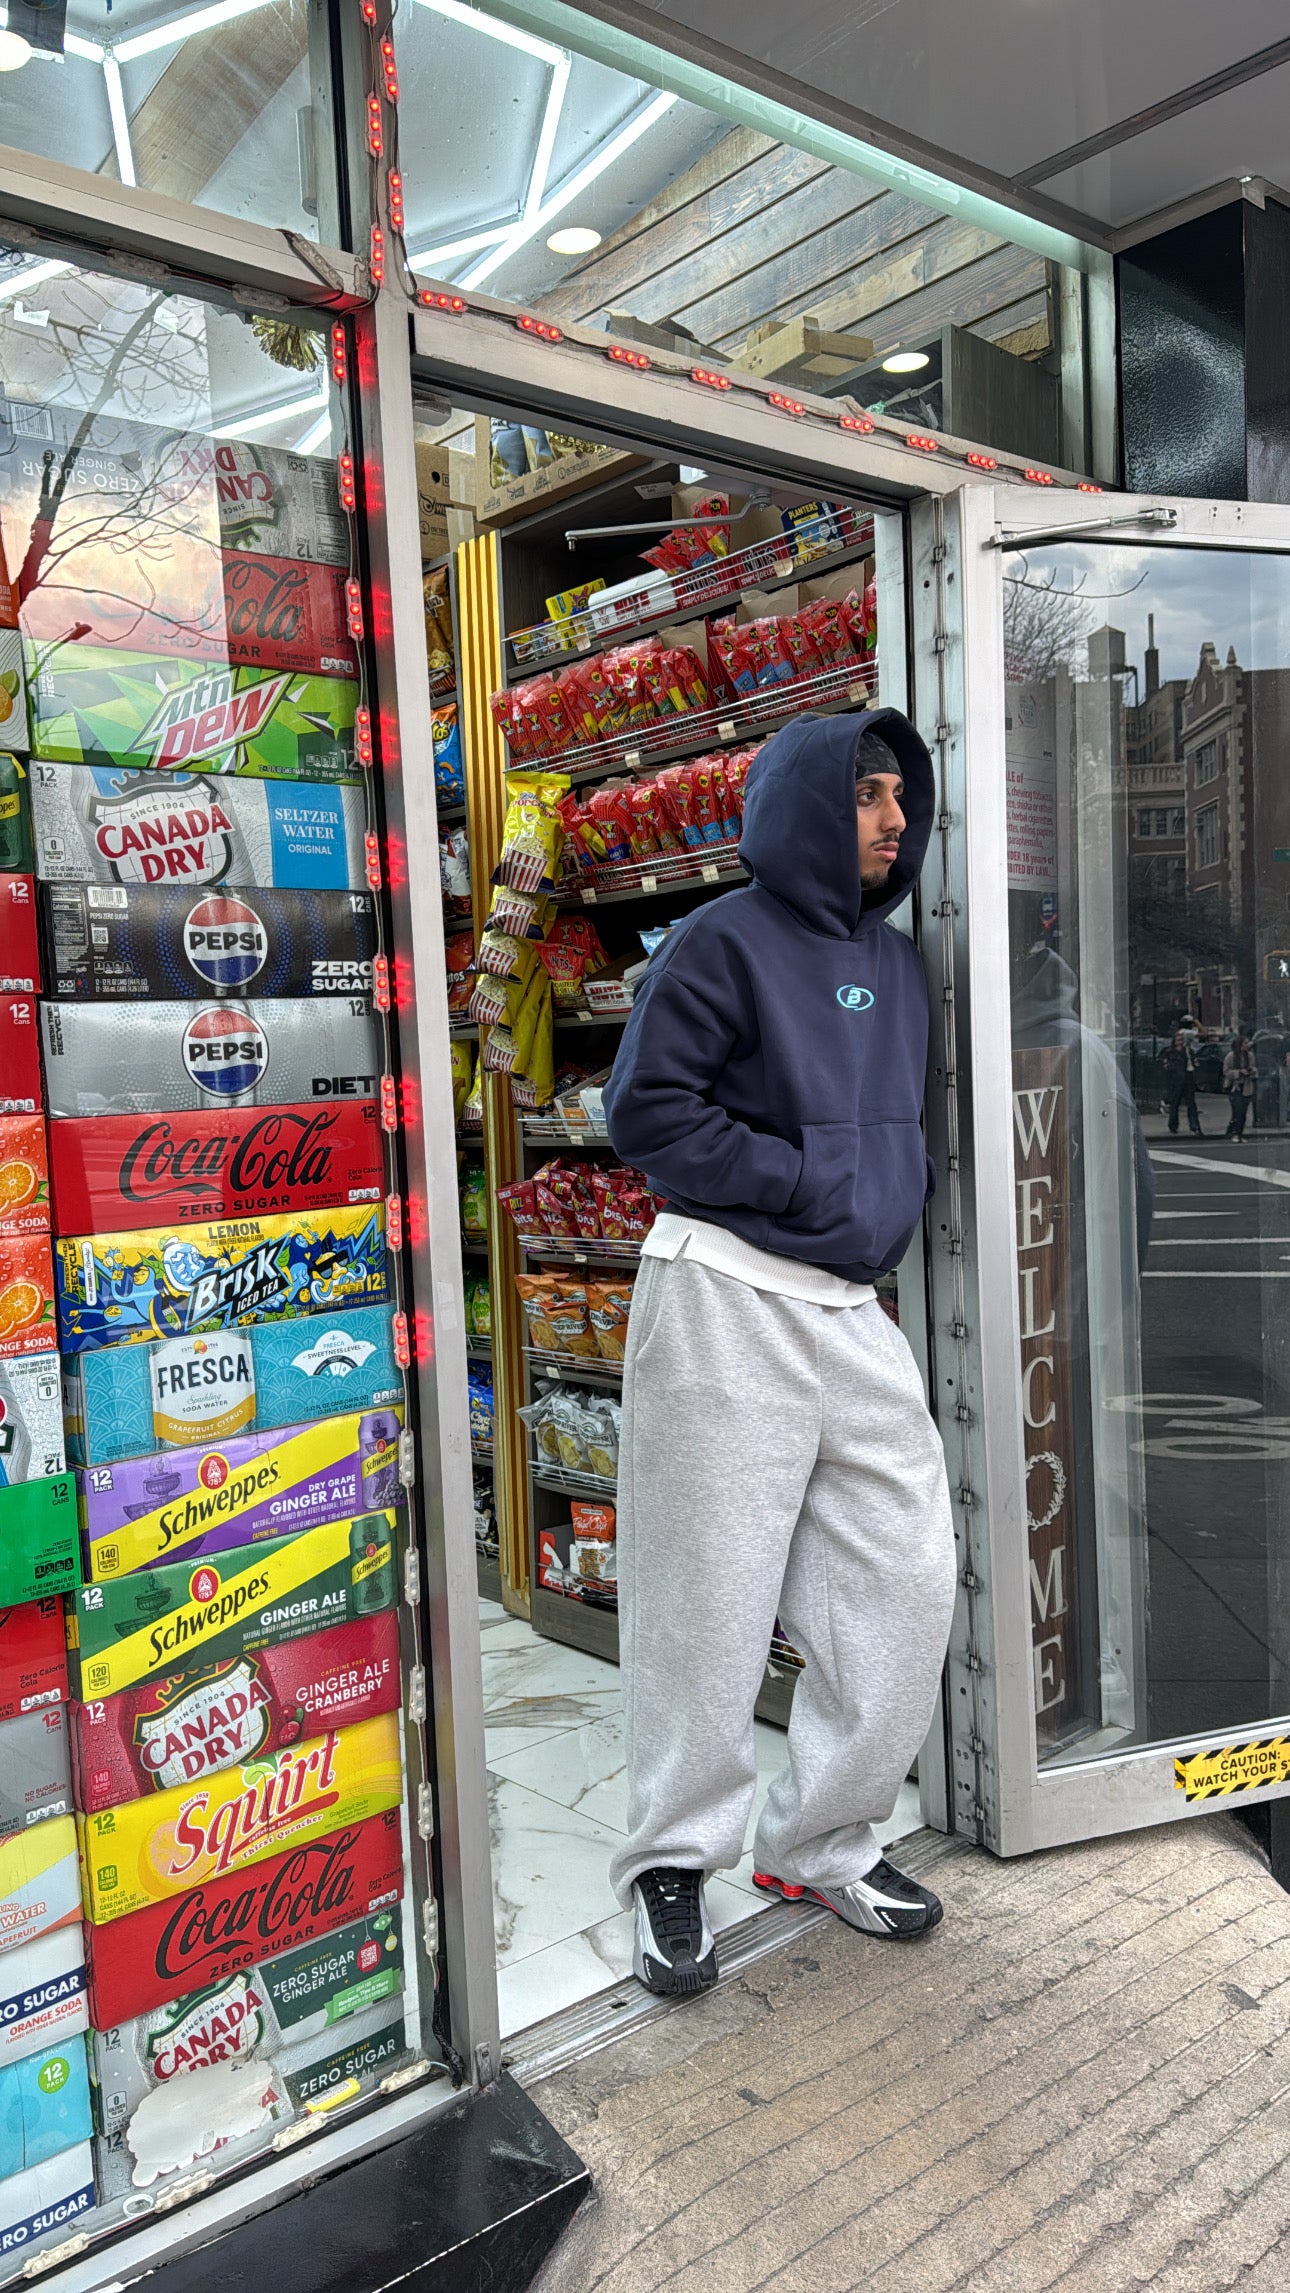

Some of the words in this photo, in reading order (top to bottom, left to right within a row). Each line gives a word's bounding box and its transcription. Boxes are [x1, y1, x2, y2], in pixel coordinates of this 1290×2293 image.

[179, 446, 238, 477] DRY
[94, 472, 139, 491] ZERO
[788, 501, 819, 520] PLANTERS
[203, 639, 261, 658] SUGAR
[36, 766, 57, 782] 12
[130, 804, 158, 820] SINCE
[161, 801, 185, 810] 1904
[274, 807, 339, 825] SELTZER
[96, 804, 233, 859] CANADA
[282, 824, 336, 840] WATER
[288, 843, 332, 855] ORIGINAL
[139, 841, 207, 882] DRY
[1022, 853, 1029, 862] 18
[1030, 855, 1047, 865] years
[1027, 865, 1034, 875] BY
[8, 882, 29, 897] 12
[349, 896, 365, 912] 12
[189, 931, 263, 951] PEPSI
[312, 961, 374, 976] ZERO
[9, 1003, 30, 1018] 12
[349, 1000, 364, 1016] 12
[54, 1005, 64, 1055] RECYCLE
[189, 1041, 263, 1061] PEPSI
[312, 1075, 376, 1096] DIET
[361, 1106, 376, 1118] 12
[119, 1111, 341, 1203] Coca-Cola
[178, 1202, 226, 1217] ZERO
[233, 1195, 291, 1211] SUGAR
[19, 1217, 48, 1228] SODA
[207, 1222, 260, 1239] LEMON
[68, 1242, 79, 1293] RECYCLE
[367, 1274, 381, 1290] 12
[237, 1287, 259, 1313] ICED
[262, 1279, 279, 1296] TEA
[24, 1337, 54, 1348] SODA
[307, 1348, 343, 1359] SWEETNESS
[344, 1344, 362, 1353] LEVEL
[158, 1354, 249, 1398] FRESCA
[182, 1404, 202, 1413] SODA
[204, 1399, 228, 1409] WATER
[1012, 1085, 1068, 1715] WELCOME
[168, 1422, 214, 1434] GRAPEFRUIT
[217, 1409, 244, 1428] CITRUS
[44, 1460, 63, 1475] 12
[366, 1447, 398, 1474] Schweppes
[90, 1469, 113, 1486] 12
[309, 1480, 325, 1492] DRY
[328, 1475, 356, 1487] GRAPE
[51, 1483, 68, 1498] 12
[94, 1484, 113, 1493] PACK
[52, 1497, 69, 1506] CANS
[158, 1461, 279, 1552] Schweppes
[270, 1490, 327, 1515] GINGER
[331, 1483, 356, 1499] ALE
[100, 1548, 116, 1558] 140
[356, 1550, 389, 1578] Schweppes
[81, 1587, 104, 1605] 12
[199, 1591, 213, 1599] 1783
[36, 1597, 56, 1613] 12
[85, 1602, 104, 1612] PACK
[260, 1599, 317, 1625] GINGER
[321, 1589, 347, 1607] ALE
[149, 1571, 269, 1667] Schweppes
[20, 1672, 37, 1682] Zero
[39, 1663, 65, 1676] Calorie
[91, 1666, 107, 1677] 120
[320, 1663, 349, 1677] CAFFEINE
[352, 1657, 366, 1667] FREE
[20, 1679, 38, 1689] Cola
[296, 1673, 358, 1702] GINGER
[363, 1659, 390, 1680] ALE
[305, 1677, 383, 1713] CRANBERRY
[86, 1702, 106, 1718] 12
[174, 1702, 200, 1726] SINCE
[203, 1691, 225, 1704] 1904
[42, 1710, 61, 1728] 12
[90, 1717, 107, 1726] PACK
[142, 1680, 269, 1770] CANADA
[46, 1725, 62, 1734] Cans
[181, 1721, 243, 1779] DRY
[1220, 1750, 1281, 1771] CAUTION:
[93, 1771, 109, 1783] 140
[1193, 1771, 1238, 1788] WATCH
[1242, 1762, 1277, 1778] YOUR
[36, 1782, 57, 1794] SUGAR
[36, 1783, 66, 1799] CALORIES
[168, 1731, 340, 1876] Squirt
[180, 1798, 195, 1812] Since
[93, 1813, 116, 1831] 12
[382, 1812, 396, 1826] 12
[97, 1828, 117, 1836] PACK
[242, 1837, 273, 1860] Thirst
[276, 1814, 323, 1840] Quencher
[249, 1825, 276, 1843] caffeine
[277, 1817, 291, 1828] free
[100, 1868, 115, 1880] 140
[368, 1876, 382, 1887] Zero
[155, 1826, 363, 1980] Coca-Cola
[0, 1902, 47, 1928] WATER
[209, 1952, 254, 1979] ZERO
[260, 1925, 314, 1956] SUGAR
[294, 1958, 319, 1972] CAFFEINE
[319, 1952, 332, 1962] FREE
[272, 1972, 307, 1997] ZERO
[311, 1950, 355, 1979] SUGAR
[23, 1975, 80, 2012] SUGAR
[282, 1978, 325, 2003] GINGER
[328, 1965, 348, 1982] ALE
[9, 2011, 53, 2036] ORANGE
[55, 1998, 82, 2018] SODA
[181, 2015, 204, 2038] SINCE
[206, 2002, 225, 2016] 1904
[103, 2029, 121, 2047] 12
[154, 1989, 263, 2080] CANADA
[105, 2043, 122, 2052] PACK
[188, 2026, 241, 2072] DRY
[327, 2051, 355, 2068] CAFFEINE
[357, 2042, 370, 2053] FREE
[44, 2062, 64, 2081] 12
[301, 2067, 340, 2098] ZERO
[346, 2038, 396, 2074] SUGAR
[46, 2076, 64, 2089] PACK
[114, 2096, 119, 2105] 0
[105, 2131, 123, 2148] 12
[33, 2193, 88, 2233] SUGAR
